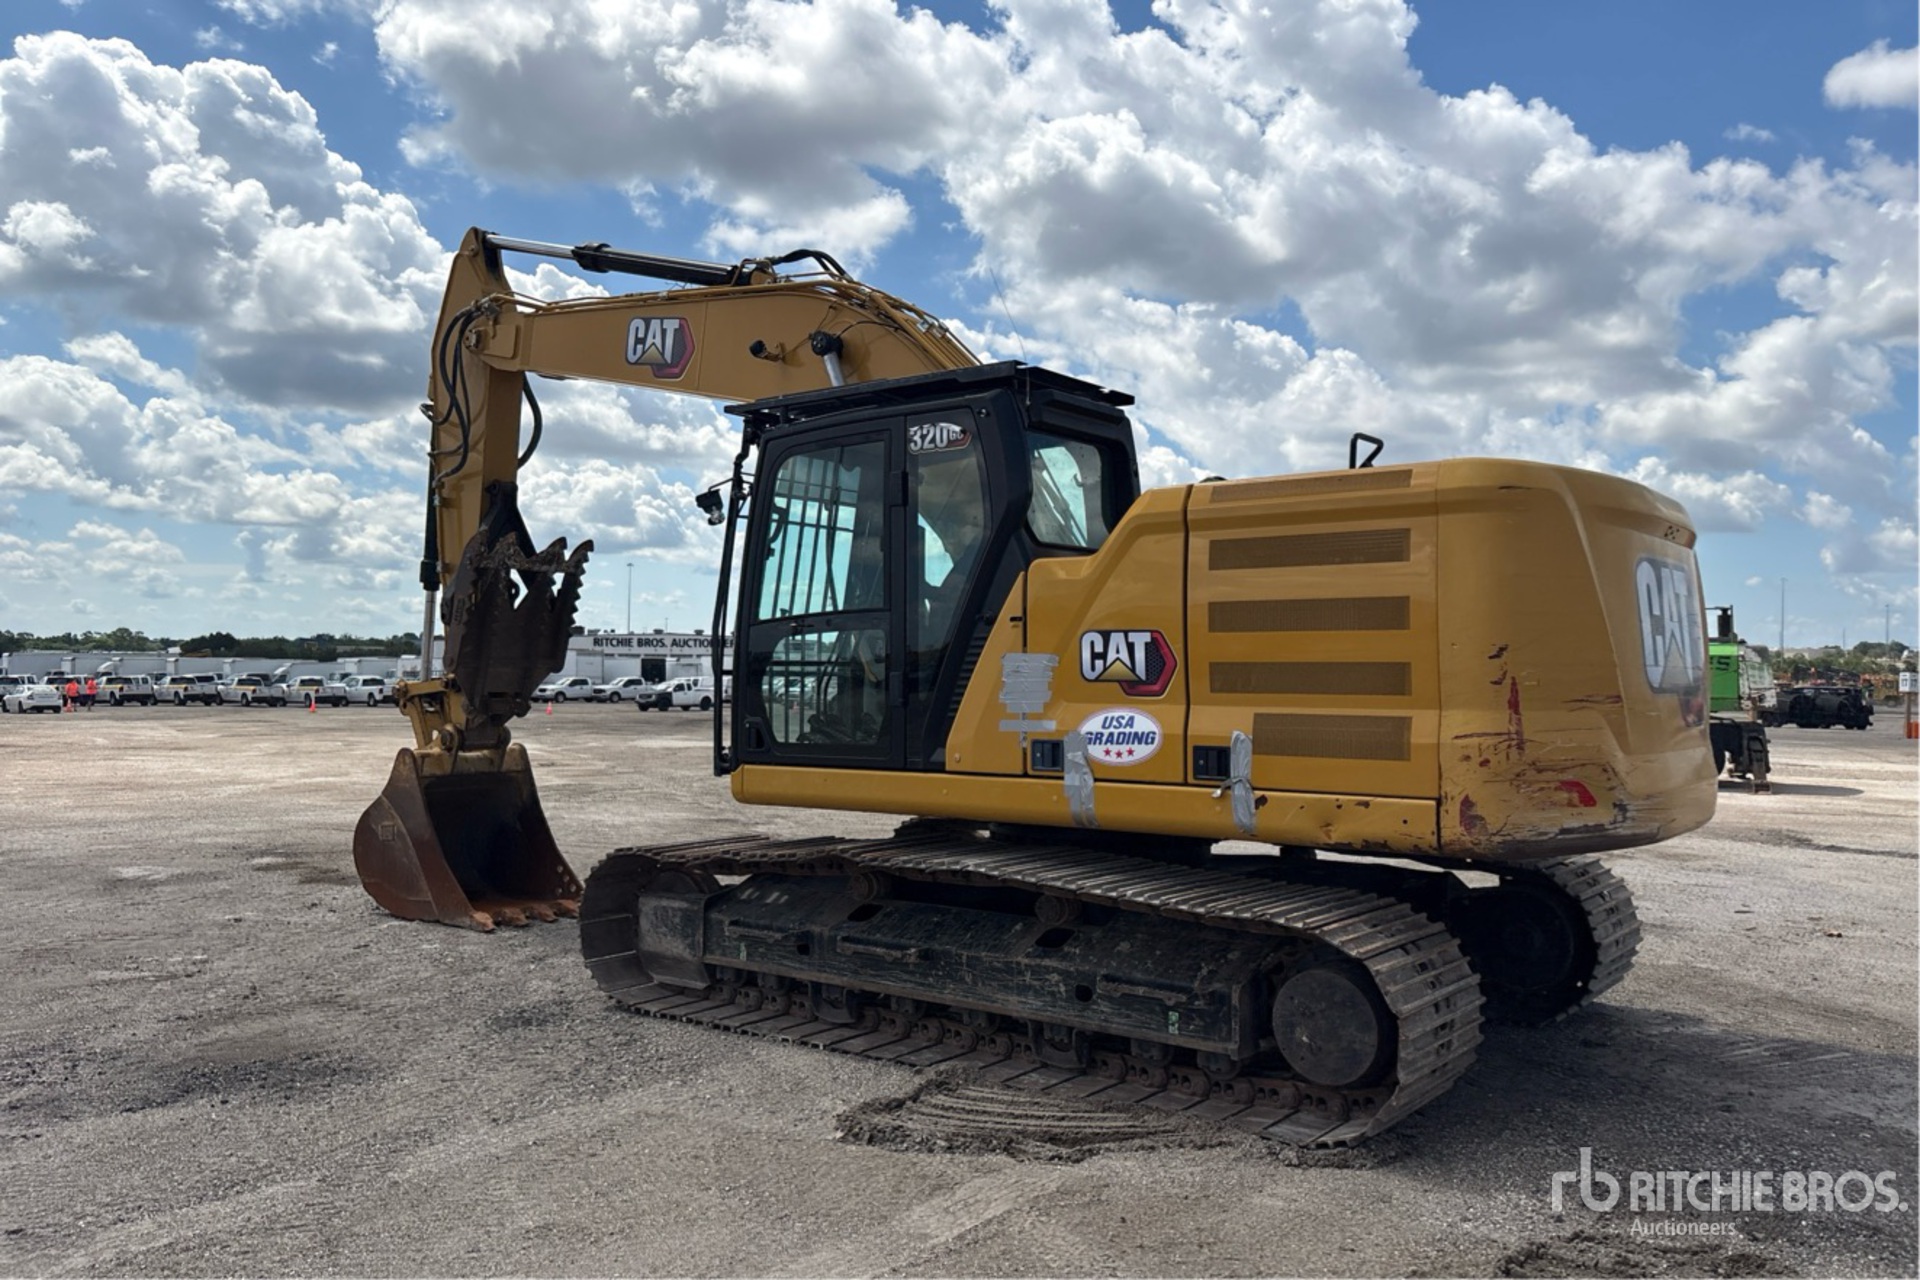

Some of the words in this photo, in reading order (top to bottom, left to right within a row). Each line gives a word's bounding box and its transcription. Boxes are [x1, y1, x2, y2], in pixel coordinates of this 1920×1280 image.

[626, 318, 680, 364] CAT
[909, 423, 949, 451] 320
[1636, 560, 1694, 688] CAT
[593, 637, 634, 649] RITCHIE
[637, 638, 668, 648] BROS.
[1081, 631, 1151, 681] CAT
[1101, 715, 1135, 730] USA
[1086, 731, 1157, 746] GRADING
